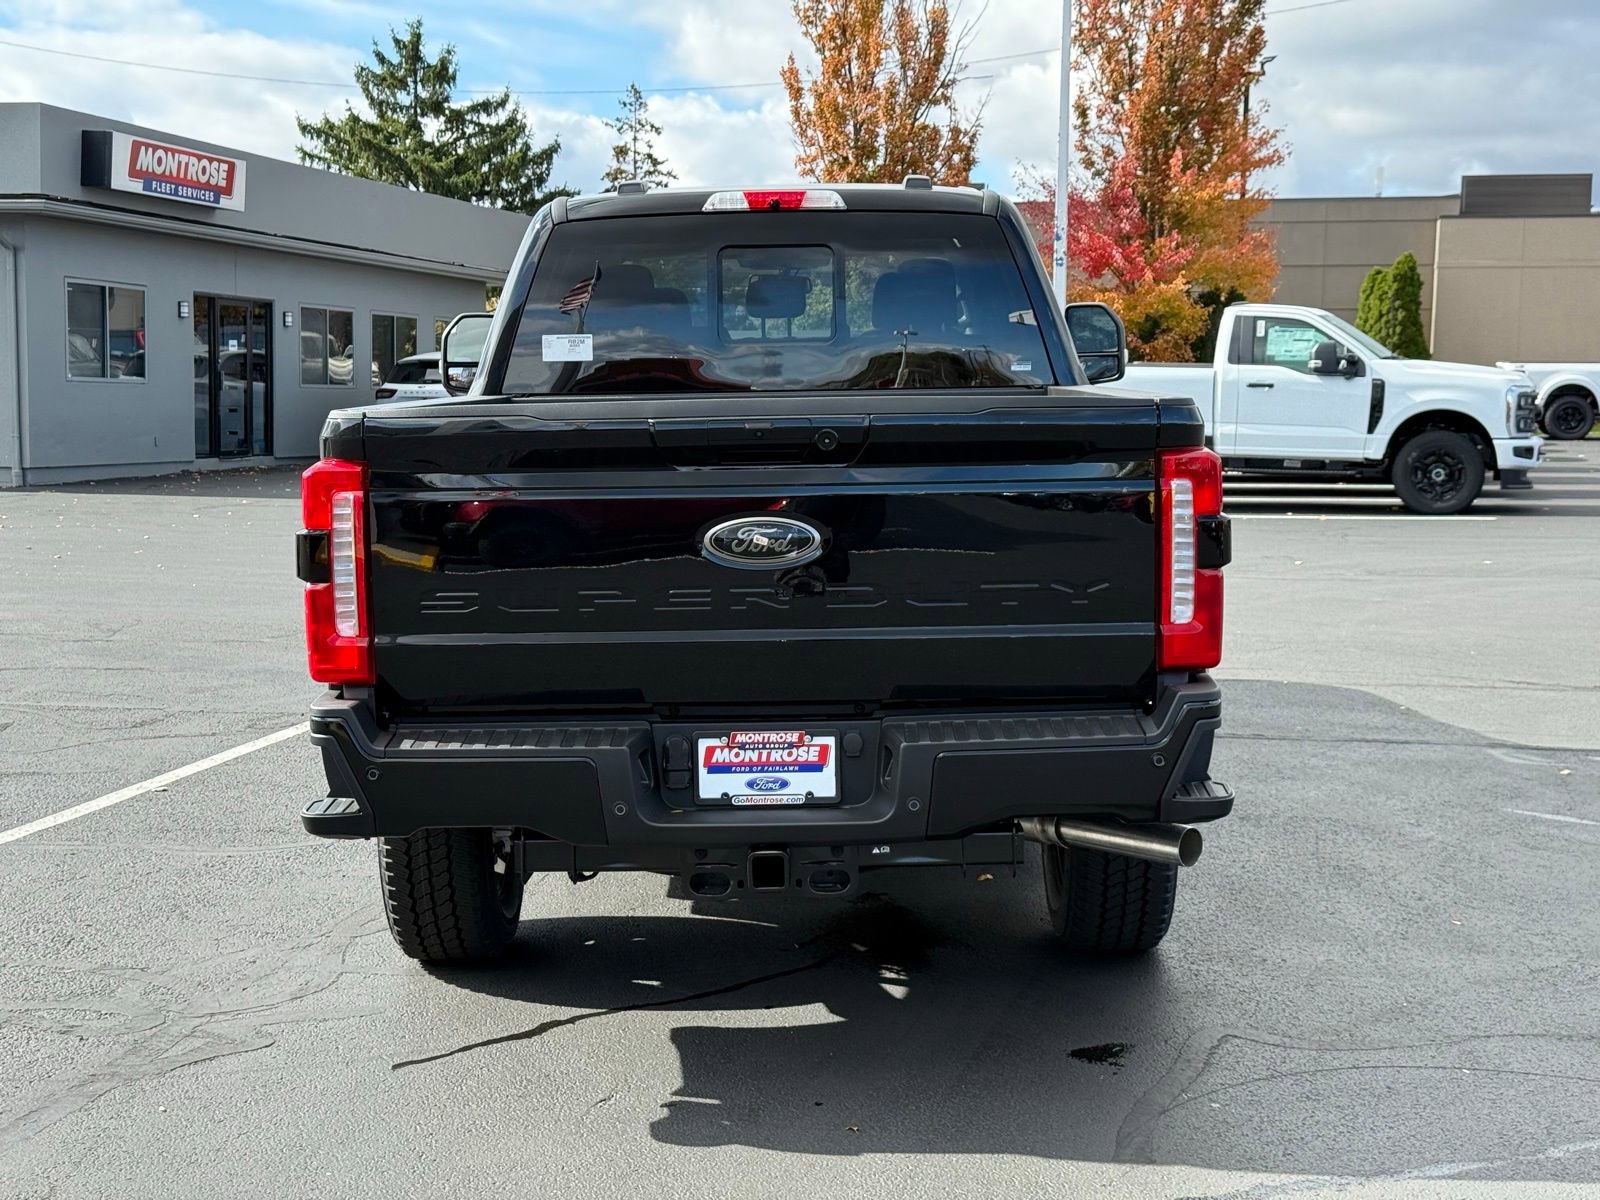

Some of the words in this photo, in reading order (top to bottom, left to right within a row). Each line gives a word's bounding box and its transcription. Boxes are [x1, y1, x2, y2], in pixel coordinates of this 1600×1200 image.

[136, 145, 228, 187] MONTROSE
[152, 180, 175, 194] FLEET
[178, 185, 214, 201] SERVICES
[731, 526, 794, 553] Ford
[734, 733, 799, 743] MONTROSE
[711, 746, 819, 763] MONTROSE
[753, 777, 781, 790] Ford
[733, 796, 804, 804] GoMontrose.com
